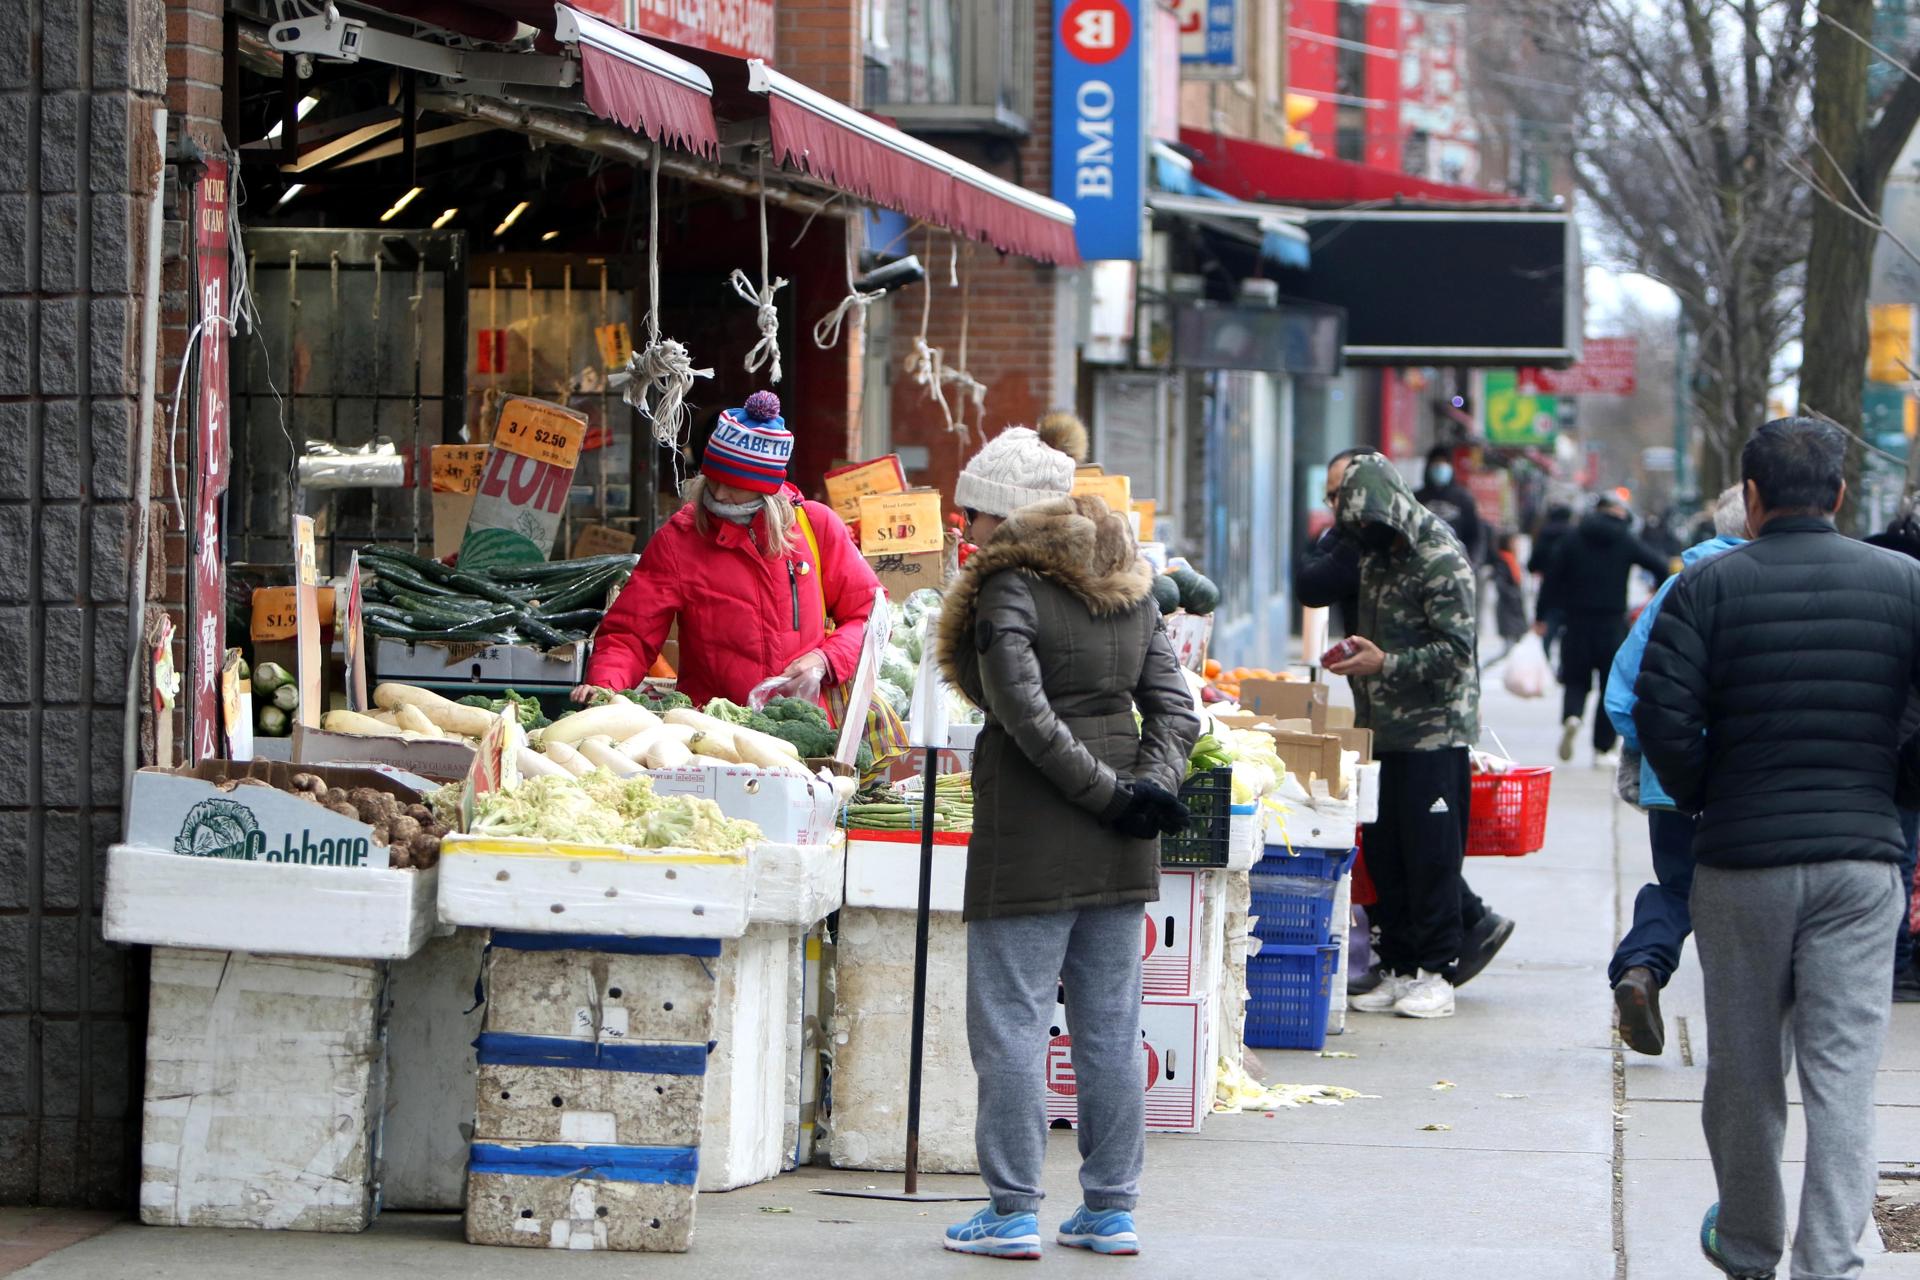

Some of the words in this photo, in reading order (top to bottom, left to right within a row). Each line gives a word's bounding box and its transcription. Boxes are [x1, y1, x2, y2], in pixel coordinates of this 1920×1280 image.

[1075, 79, 1115, 200] BMO
[509, 421, 518, 434] 3
[534, 428, 567, 448] $2.50
[480, 448, 575, 513] LON
[266, 614, 297, 627] $1.9
